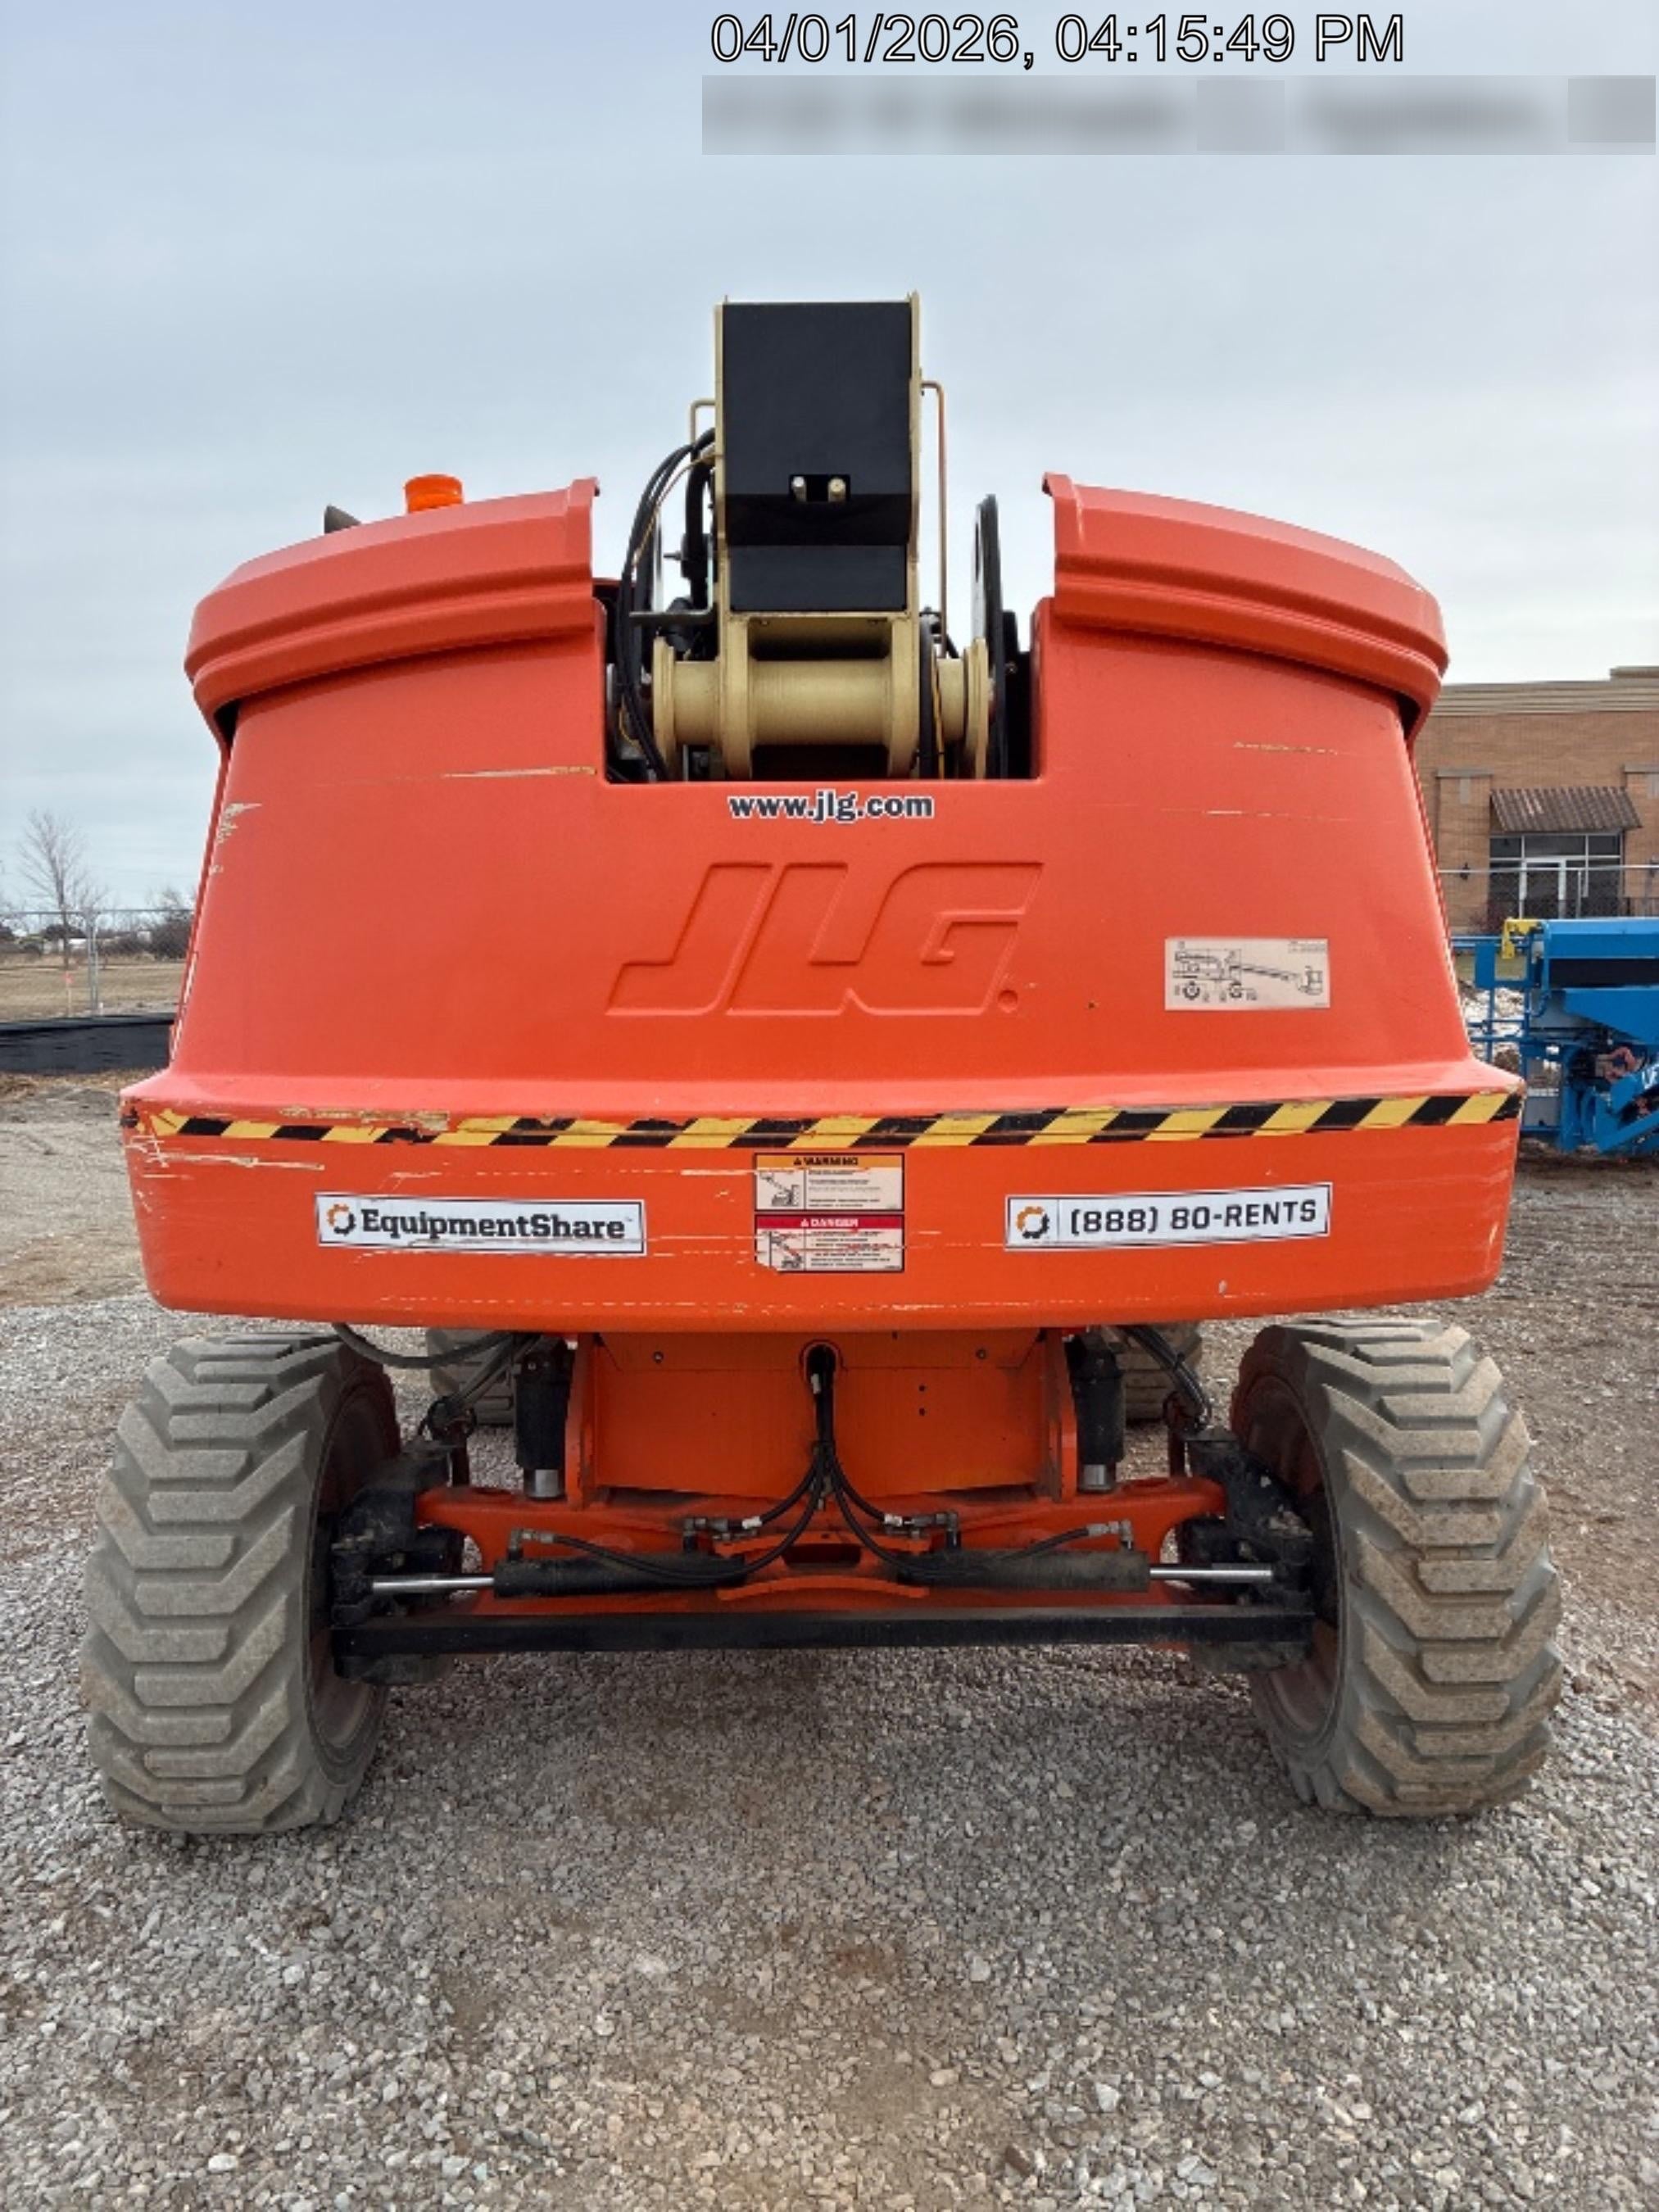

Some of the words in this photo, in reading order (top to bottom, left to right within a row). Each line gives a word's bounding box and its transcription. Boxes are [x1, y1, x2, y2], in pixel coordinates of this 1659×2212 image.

[728, 791, 935, 823] www.jlg.com
[360, 1209, 626, 1239] EquipmentShare
[1070, 1208, 1160, 1235] (888)
[1169, 1199, 1319, 1231] 80-RENTS
